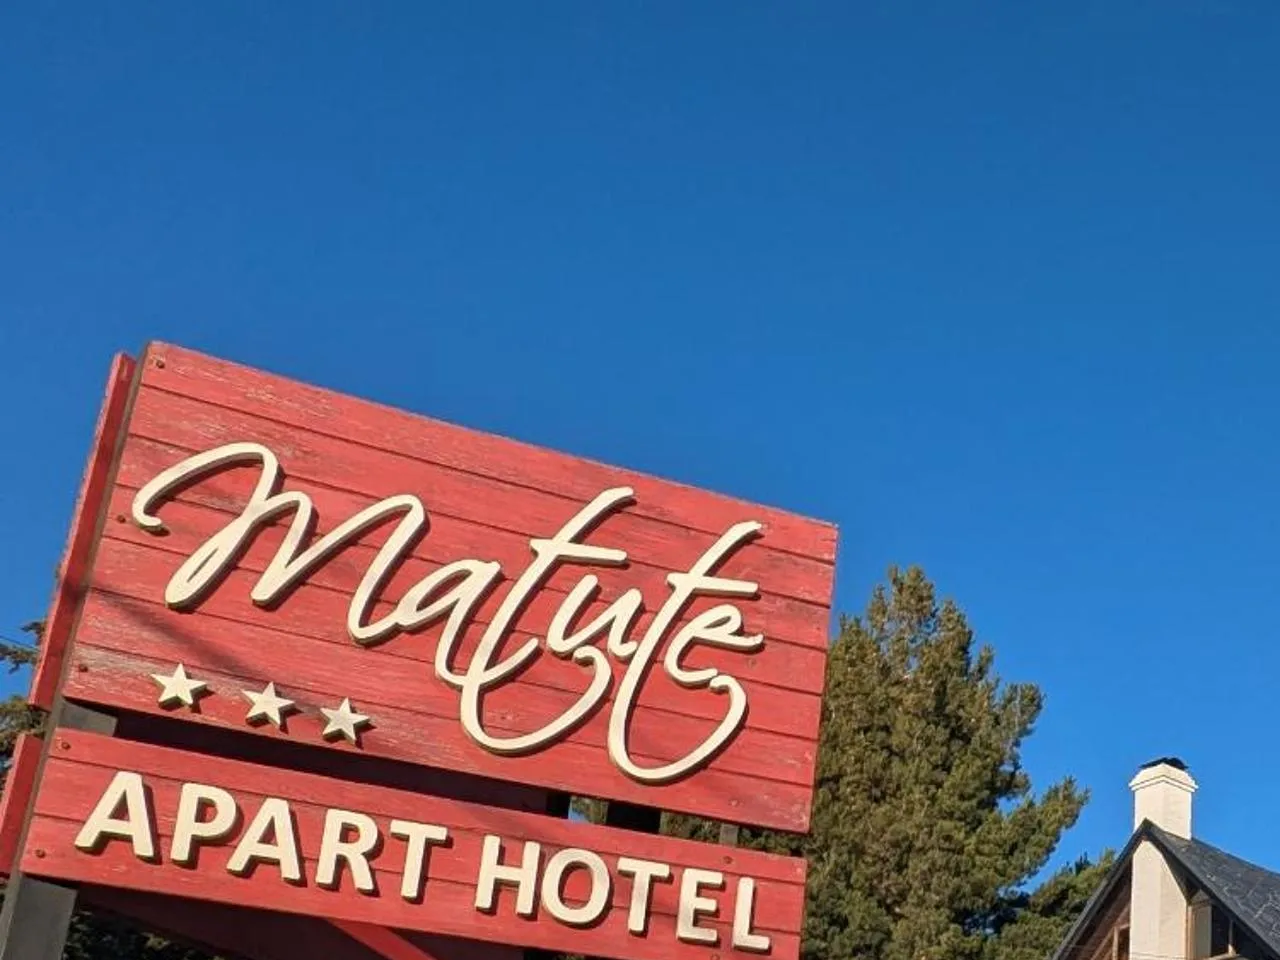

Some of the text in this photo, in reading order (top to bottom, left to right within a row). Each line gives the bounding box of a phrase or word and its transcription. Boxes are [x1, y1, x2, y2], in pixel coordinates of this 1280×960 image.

[131, 441, 766, 786] Matute
[73, 770, 772, 953] APART HOTEL
